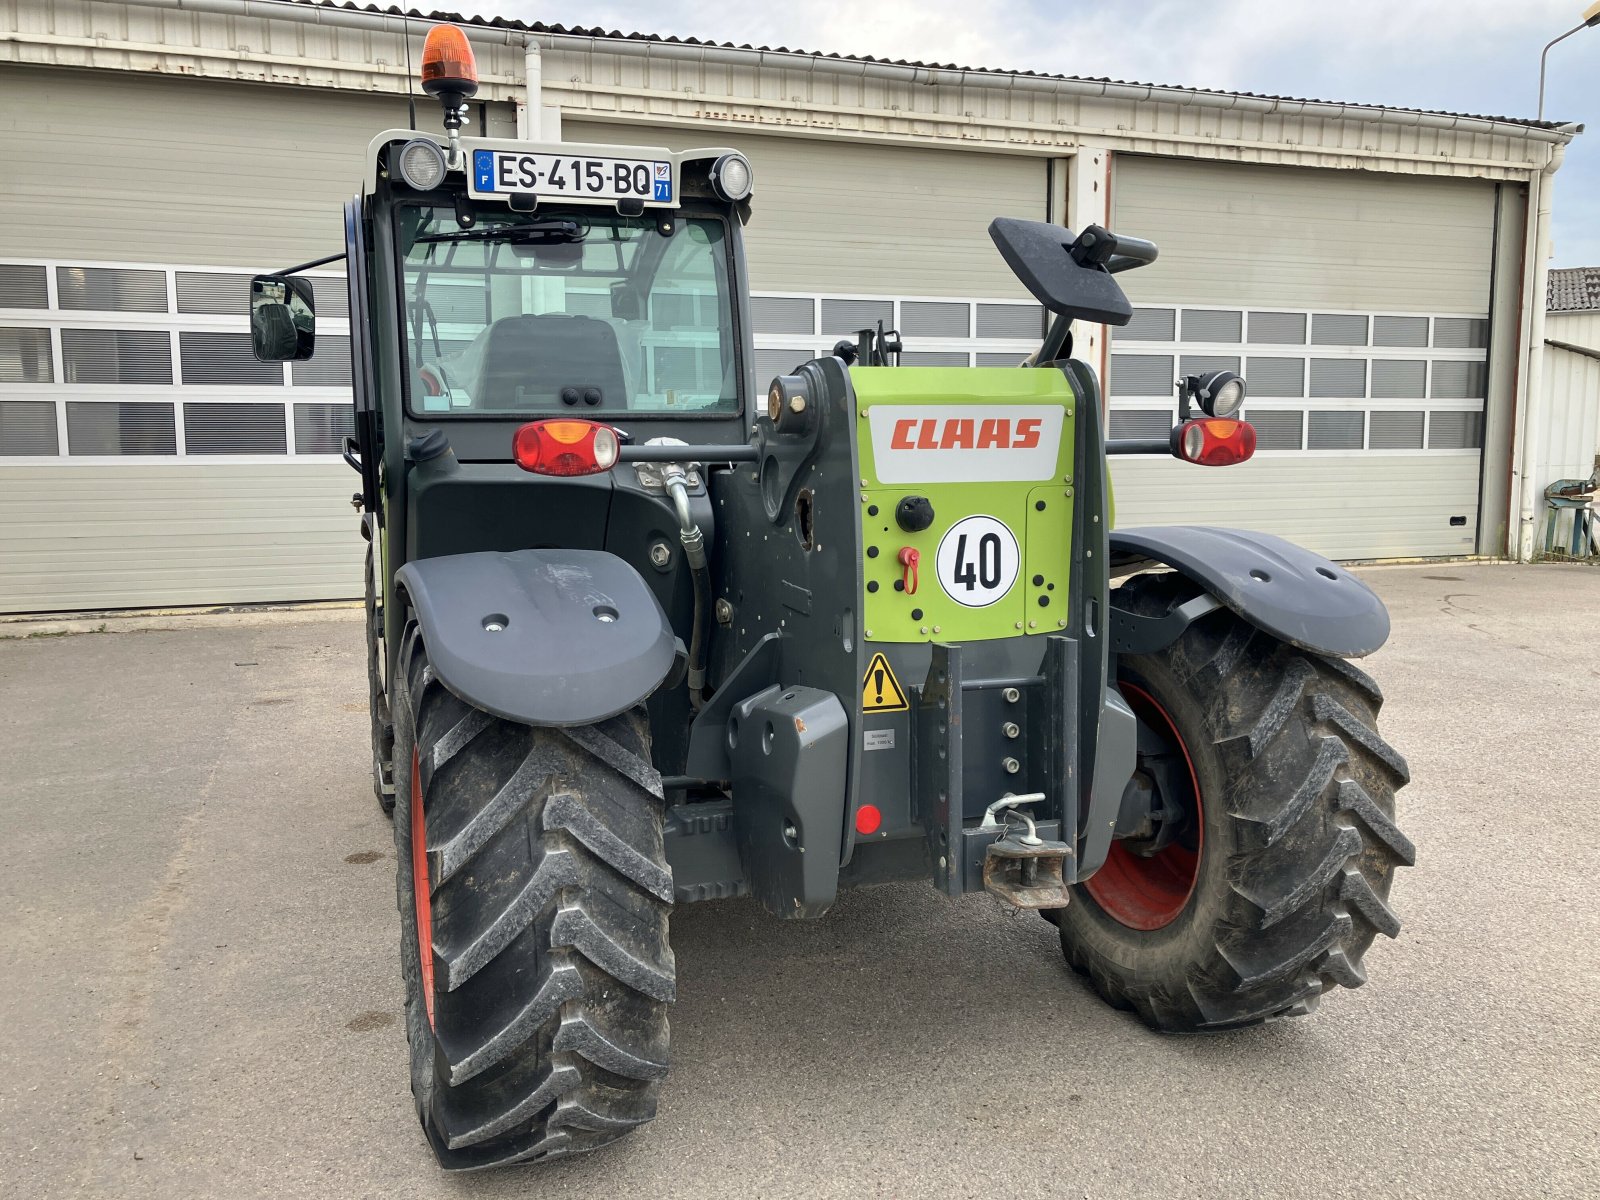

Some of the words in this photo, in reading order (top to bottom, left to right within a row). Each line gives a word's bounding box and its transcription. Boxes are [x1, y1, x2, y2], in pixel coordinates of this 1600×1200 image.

[481, 175, 488, 185] F
[499, 155, 650, 195] ES-415-BQ
[656, 184, 669, 197] 71
[890, 418, 1043, 450] CLAAS
[954, 532, 1002, 591] 40
